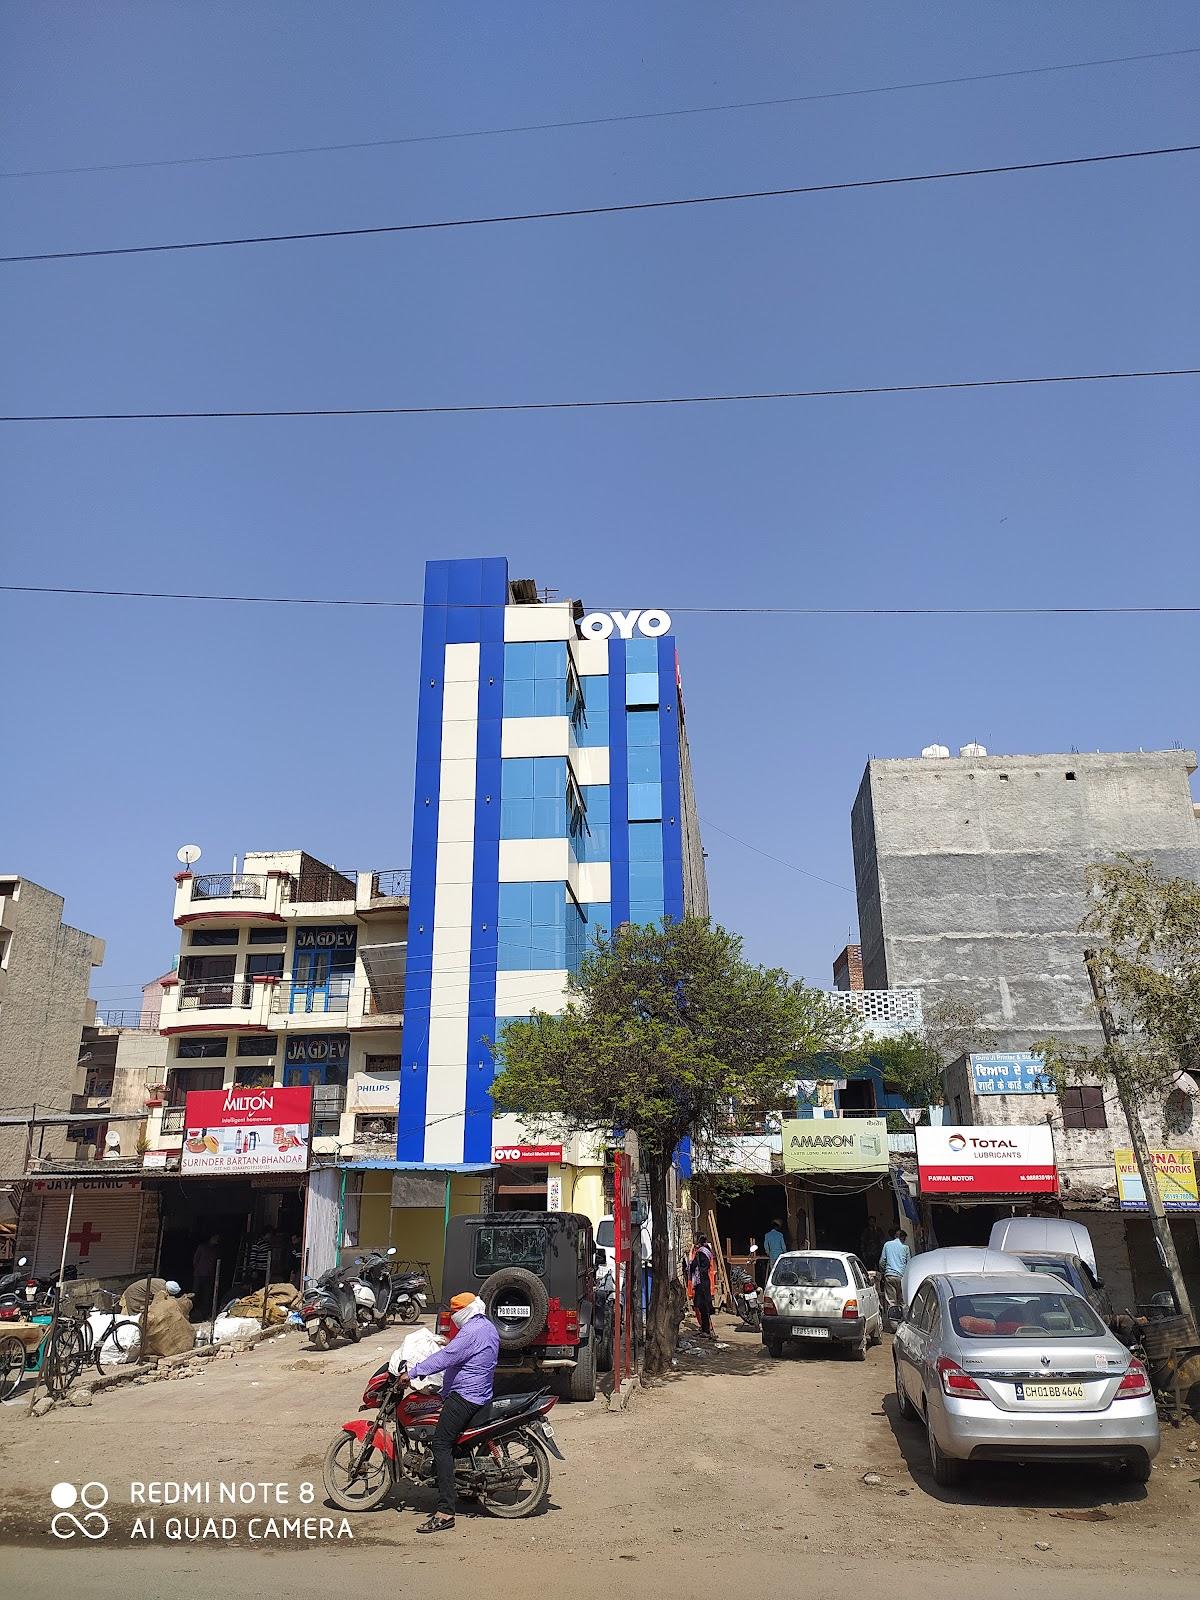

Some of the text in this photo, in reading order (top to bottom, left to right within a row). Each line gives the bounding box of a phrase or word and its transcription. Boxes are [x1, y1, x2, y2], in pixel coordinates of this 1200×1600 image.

[580, 609, 672, 641] OYO
[297, 931, 355, 946] JAGDEV
[287, 1040, 350, 1060] JAGDEV
[357, 1084, 390, 1092] PHILIPS
[977, 1079, 995, 1092] शादी
[997, 1079, 1005, 1091] के
[1007, 1077, 1022, 1091] कार्ड
[223, 1090, 274, 1112] MILTON
[790, 1135, 854, 1148] AMARON
[182, 1157, 224, 1168] SURINDER
[226, 1156, 261, 1166] BARTAN
[261, 1154, 303, 1165] BHANDAR
[495, 1149, 521, 1160] OYO
[974, 1151, 1022, 1159] LUBRICANTS
[1160, 1165, 1192, 1174] WORKS
